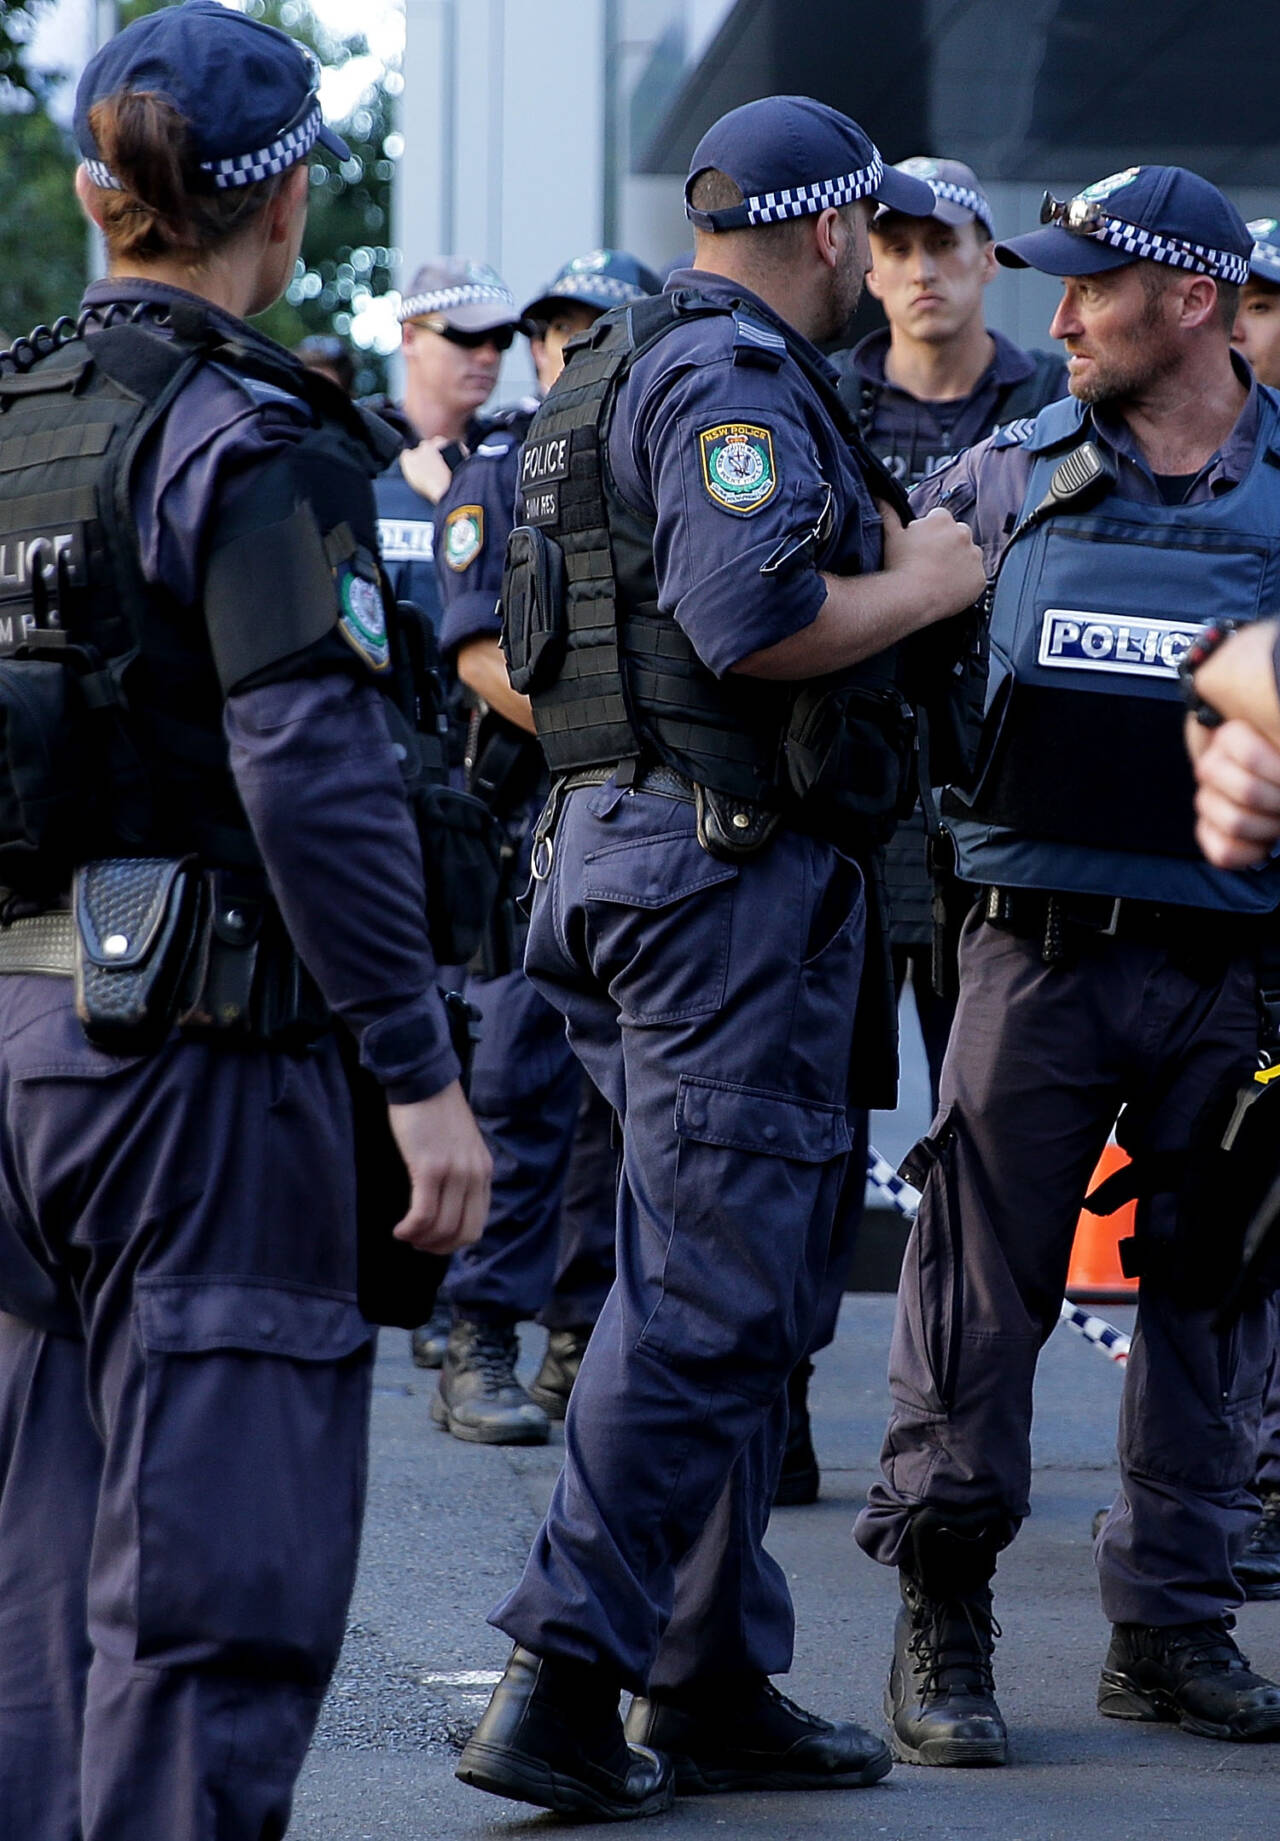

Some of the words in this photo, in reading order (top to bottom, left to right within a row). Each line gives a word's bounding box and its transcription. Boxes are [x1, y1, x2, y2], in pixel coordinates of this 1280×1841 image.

[704, 427, 728, 441] NSW
[730, 426, 767, 440] POLICE
[522, 439, 567, 481] POLICE
[0, 533, 76, 584] LICE
[380, 526, 434, 549] OLIC
[1050, 621, 1191, 668] POLIC
